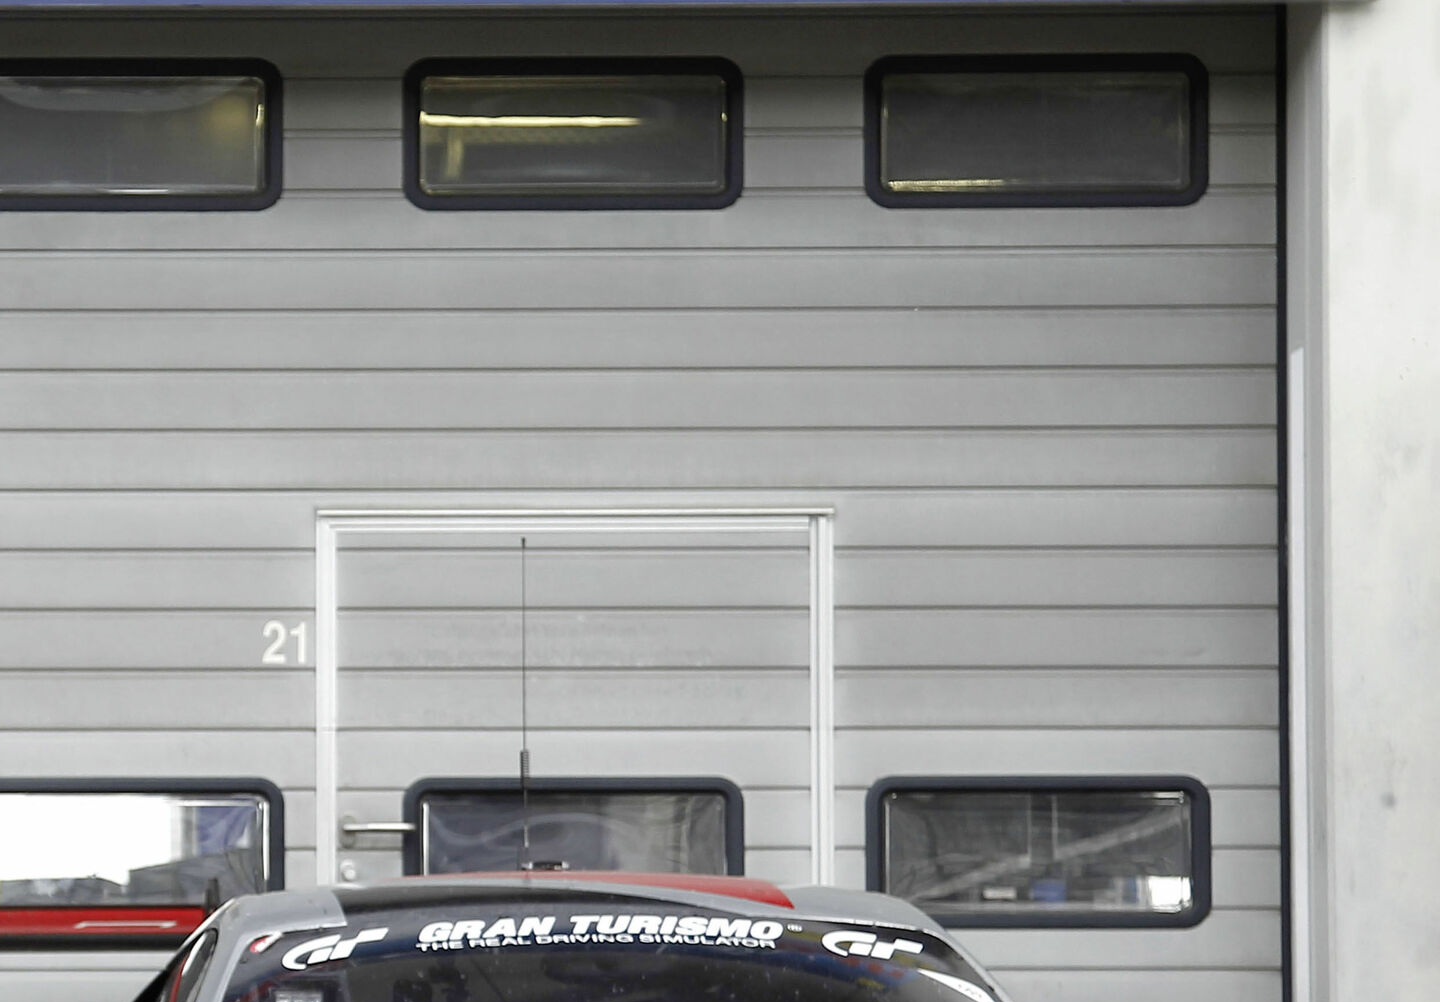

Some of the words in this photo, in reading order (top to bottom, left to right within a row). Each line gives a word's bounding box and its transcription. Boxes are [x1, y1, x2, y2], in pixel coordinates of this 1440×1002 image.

[262, 620, 307, 664] 21
[416, 941, 464, 951] THE
[469, 937, 531, 948] REAL
[535, 934, 634, 945] DRIVING
[639, 934, 776, 949] SIMULATOR
[418, 916, 556, 943] GRAN
[570, 915, 785, 941] TURISMO
